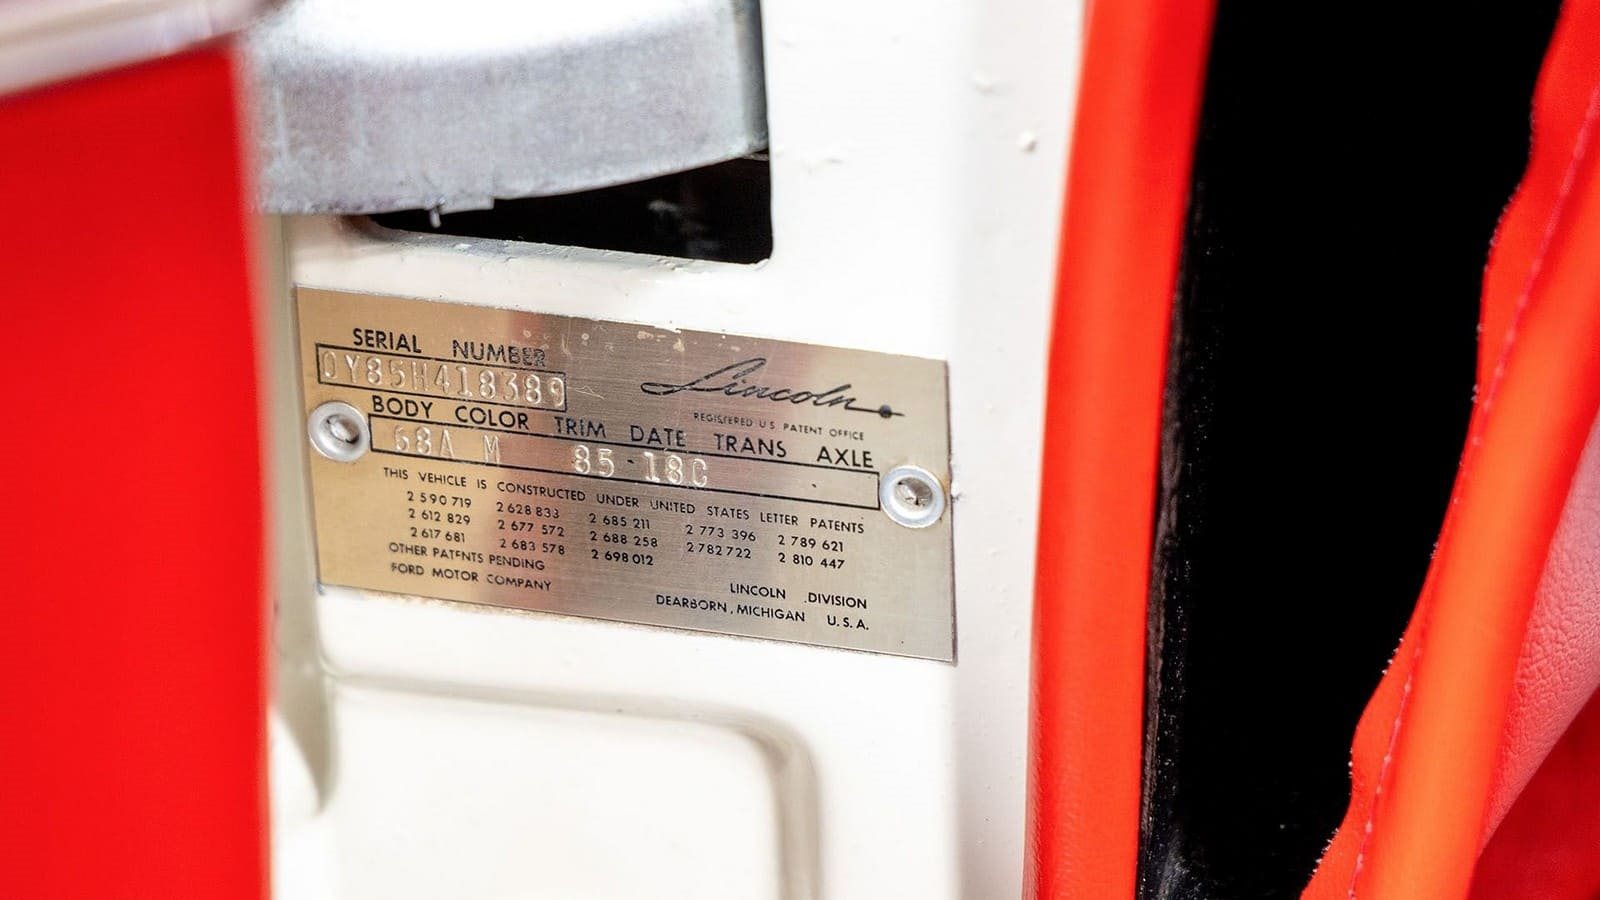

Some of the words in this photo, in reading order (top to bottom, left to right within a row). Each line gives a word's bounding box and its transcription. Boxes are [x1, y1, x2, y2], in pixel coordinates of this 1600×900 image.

[353, 328, 421, 353] SERIAL
[453, 340, 545, 367] NUMBER
[641, 358, 905, 417] Lincoln
[372, 395, 433, 418] BODY
[456, 406, 528, 430] COLOR
[555, 417, 606, 438] TRIM
[630, 425, 686, 447] DATE
[714, 433, 786, 457] TRANS
[817, 446, 873, 468] AXLE
[694, 413, 752, 427] REGISTERED
[784, 423, 824, 435] PATENT
[830, 428, 864, 440] OFFICE
[484, 435, 500, 463] M
[574, 445, 614, 476] 85
[384, 468, 408, 479] THIS
[418, 472, 466, 487] VEHICLE
[477, 479, 487, 489] IS
[497, 481, 585, 501] CONSTRUCTED
[597, 494, 639, 508] UNDER
[650, 500, 695, 514] UNITED
[707, 506, 749, 520] STATES
[760, 512, 798, 525] LETTER
[810, 518, 864, 533] PATENTS
[407, 491, 413, 502] 2
[421, 493, 447, 505] 590
[452, 497, 472, 508] 719
[409, 509, 415, 518] 2
[422, 510, 440, 521] 612
[447, 513, 471, 525] 829
[496, 502, 503, 513] 2
[507, 503, 532, 515] 628
[536, 506, 560, 519] 833
[498, 520, 505, 530] 2
[511, 522, 534, 532] 677
[542, 525, 564, 536] 572
[589, 514, 596, 523] 2
[603, 515, 626, 527] 685
[633, 518, 650, 529] 211
[410, 527, 417, 537] 2
[422, 529, 440, 539] 617
[446, 532, 465, 542] 681
[590, 531, 597, 541] 2
[603, 532, 627, 545] 688
[633, 535, 658, 547] 258
[686, 525, 693, 534] 2
[700, 526, 724, 538] 773
[732, 530, 756, 542] 396
[500, 538, 506, 548] 2
[512, 540, 536, 551] 683
[542, 543, 565, 555] 578
[687, 542, 694, 552] 2
[698, 543, 722, 555] 782
[726, 547, 751, 559] 722
[778, 535, 785, 545] 2
[791, 537, 815, 548] 789
[822, 540, 843, 552] 621
[389, 542, 427, 556] OTHER
[433, 548, 484, 563] PATENTS
[489, 555, 544, 570] PENDING
[592, 549, 599, 559] 2
[605, 551, 629, 562] 698
[633, 554, 654, 565] 012
[778, 553, 785, 563] 2
[793, 554, 813, 566] 810
[821, 557, 845, 569] 447
[391, 562, 424, 575] FORD
[432, 568, 479, 582] MOTOR
[487, 574, 551, 591] COMPANY
[730, 583, 785, 599] LINCOLN
[737, 604, 805, 622] MICHIGAN
